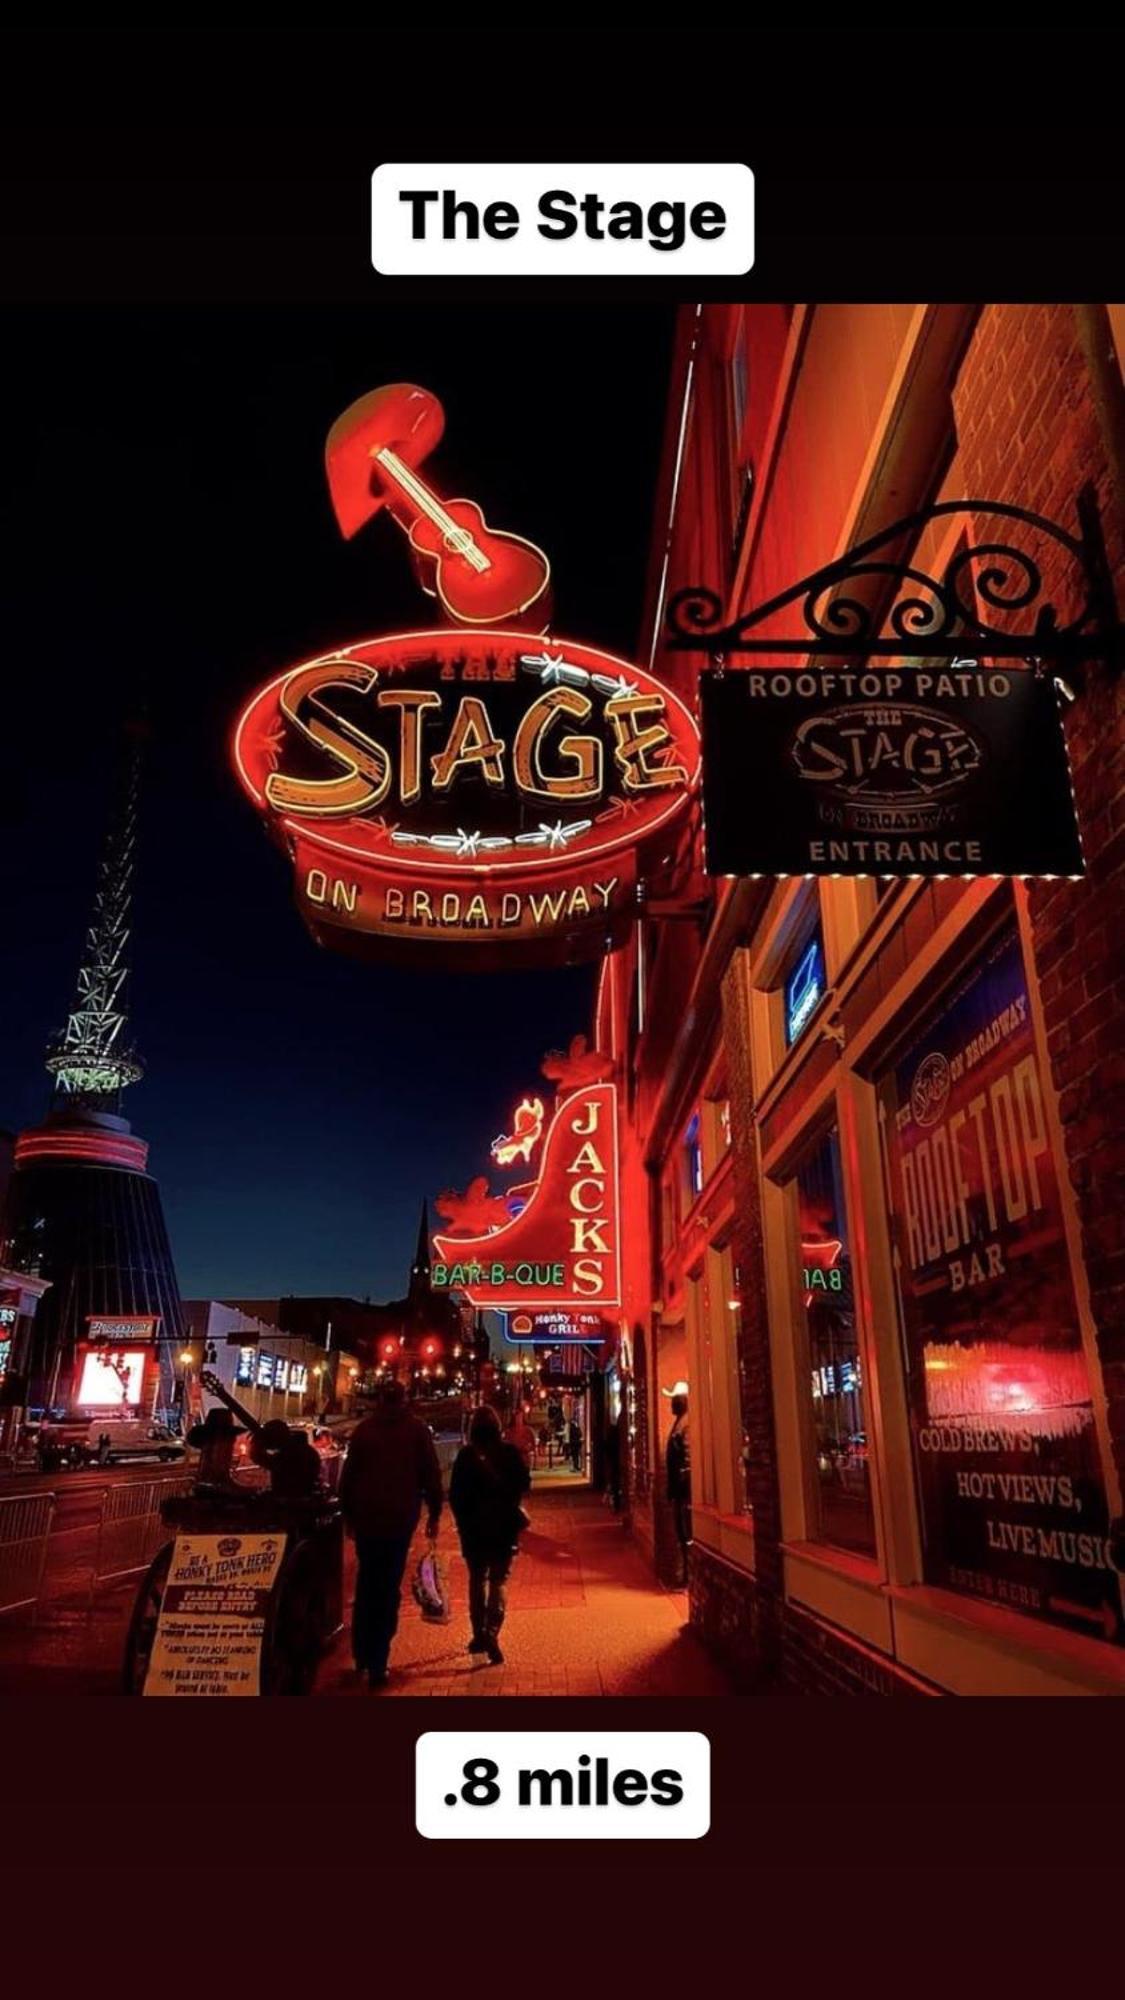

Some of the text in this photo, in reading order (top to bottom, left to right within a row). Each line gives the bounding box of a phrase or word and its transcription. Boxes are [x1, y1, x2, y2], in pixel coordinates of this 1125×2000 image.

[749, 674, 1012, 698] ROOFTOP PATIO
[266, 660, 688, 813] STAGE
[863, 710, 902, 726] THE
[797, 717, 980, 780] STAGE
[809, 840, 982, 862] ENTRANCE
[305, 869, 618, 926] ON BROADWAY
[965, 993, 1026, 1069] BROADWAY
[901, 1053, 1047, 1271] ROOFTOP
[567, 1102, 612, 1296] JACKS
[432, 1262, 565, 1287] BAR-B-QUE
[949, 1243, 1006, 1292] BAR
[919, 1427, 1040, 1457] COLD BREWS,
[957, 1472, 1082, 1513] HOT VIEWS,
[987, 1519, 1036, 1556] LIVE
[174, 1563, 212, 1579] HONKY
[215, 1556, 246, 1575] TONK
[246, 1551, 276, 1569] HERO
